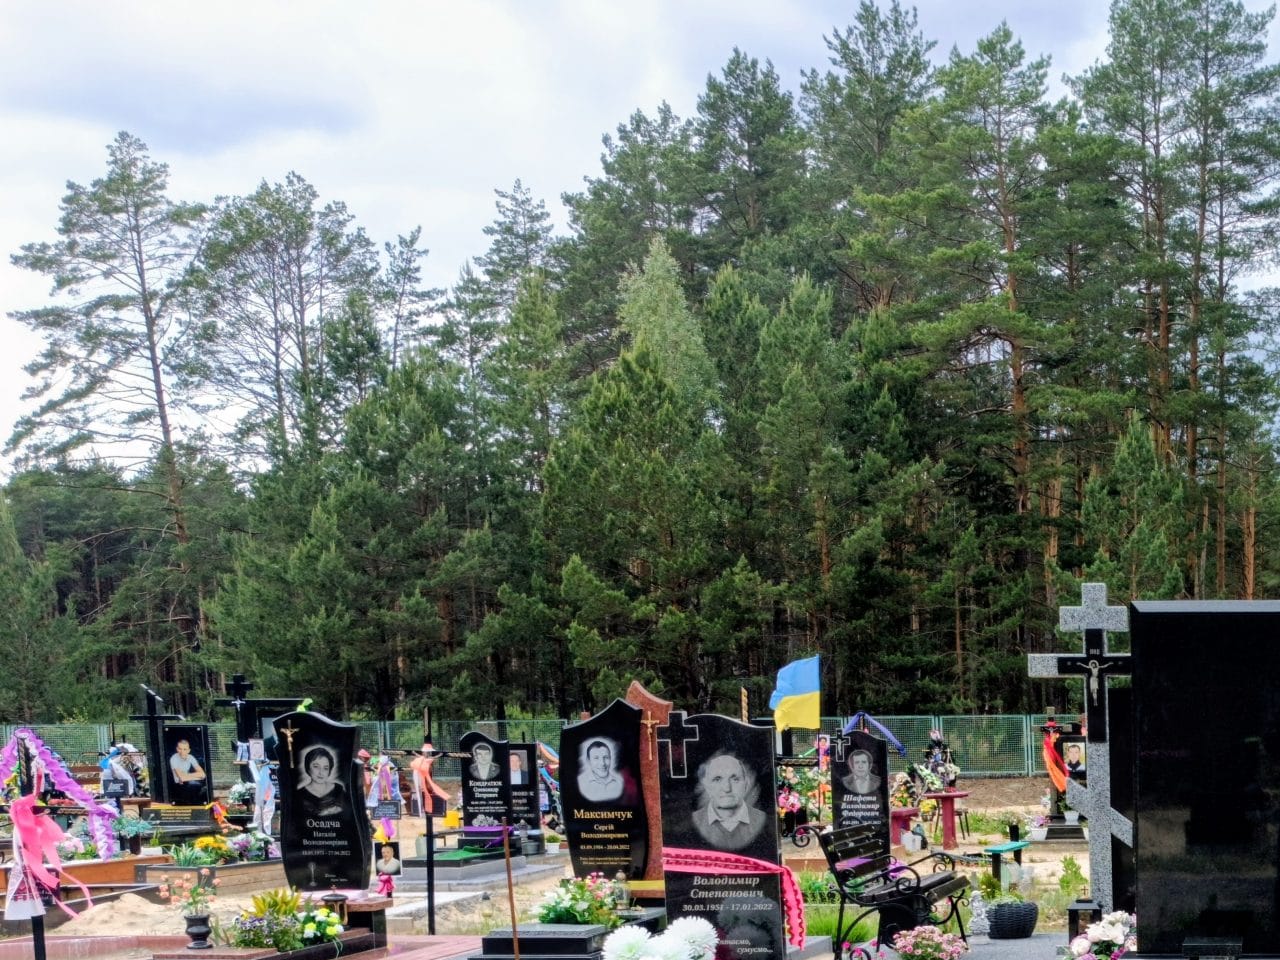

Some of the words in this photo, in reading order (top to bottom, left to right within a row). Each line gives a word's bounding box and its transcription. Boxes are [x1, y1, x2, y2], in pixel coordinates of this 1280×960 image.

[574, 809, 633, 820] Максимчук
[306, 819, 341, 828] Осадча
[693, 875, 760, 886] Володимир
[690, 889, 764, 898] Степанович
[730, 903, 773, 911] 17.01.2022
